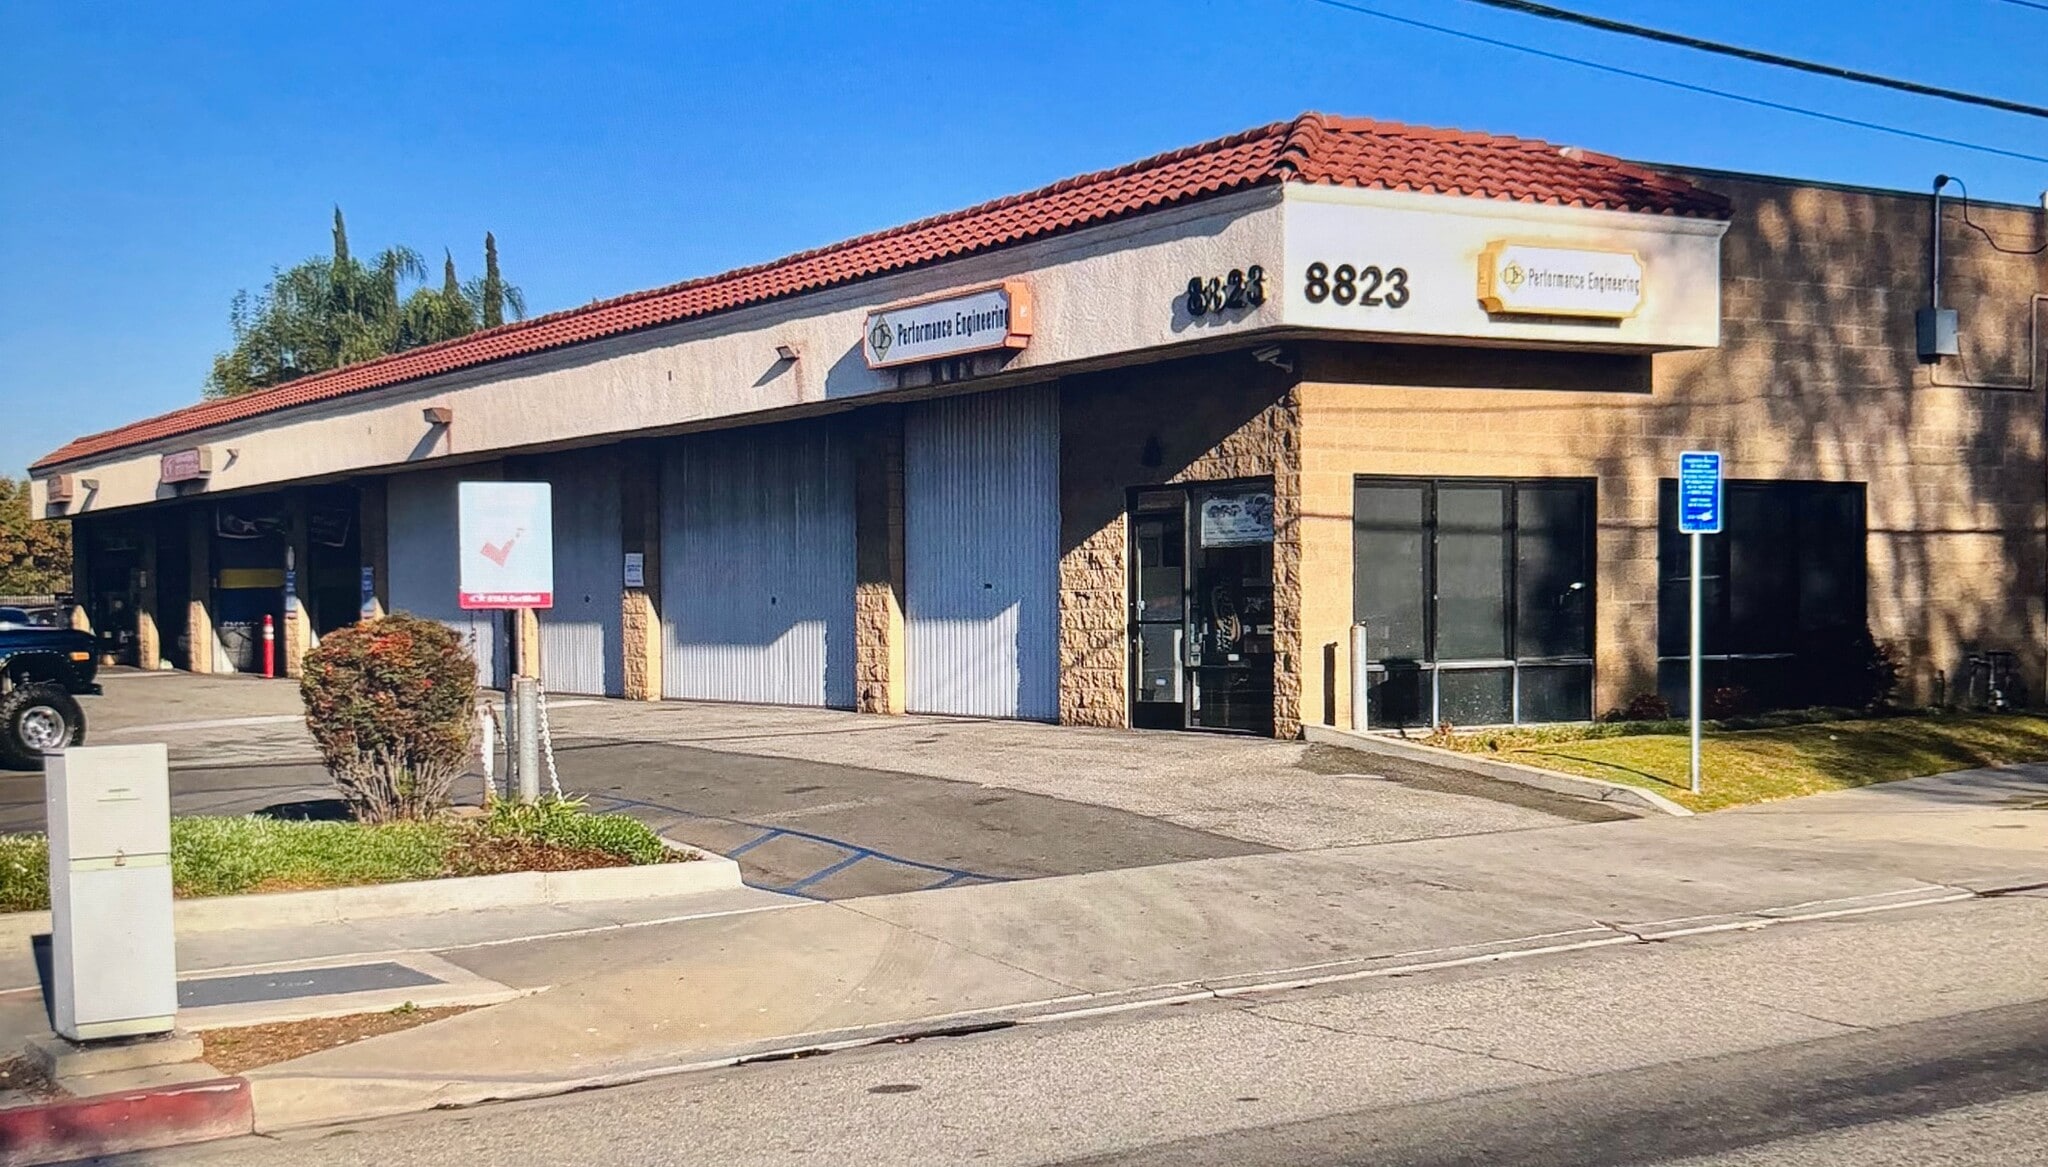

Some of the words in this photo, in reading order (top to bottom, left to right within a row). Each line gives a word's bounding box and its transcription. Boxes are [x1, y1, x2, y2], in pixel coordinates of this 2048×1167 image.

[1187, 264, 1266, 317] 8823
[1305, 262, 1410, 308] 8823
[1528, 268, 1585, 290] Performance
[1588, 271, 1640, 296] Engineering
[897, 317, 953, 347] Performance
[956, 304, 1009, 337] Engineering
